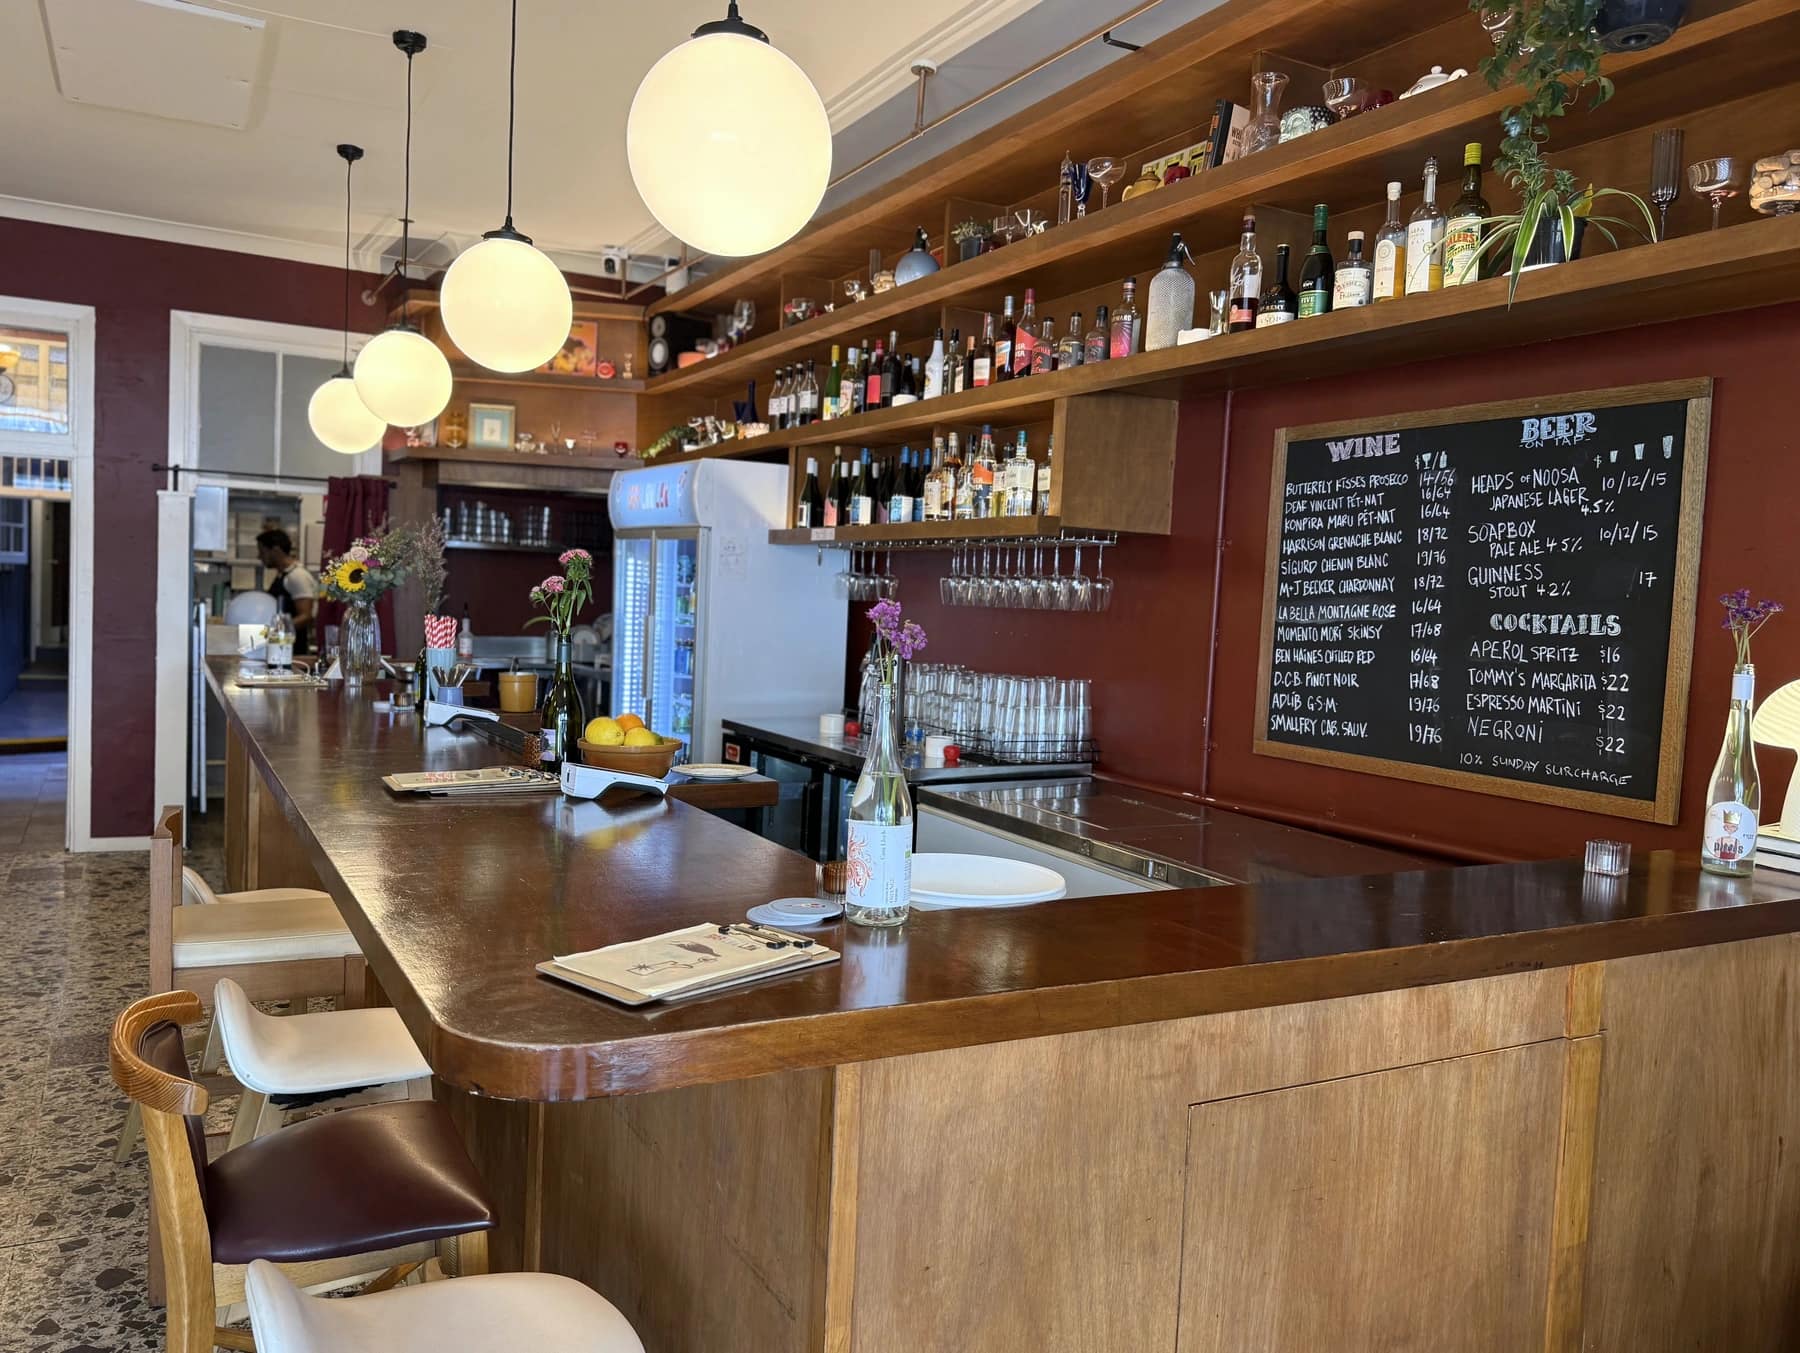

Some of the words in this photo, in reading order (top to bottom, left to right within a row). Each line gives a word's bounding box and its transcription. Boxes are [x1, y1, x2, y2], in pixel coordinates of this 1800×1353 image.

[1520, 412, 1597, 443] BEER
[1326, 434, 1400, 462] WINE
[1286, 480, 1332, 497] BUTTERFLY
[1336, 476, 1366, 492] KISSES
[1369, 473, 1408, 488] PROSECCO
[1419, 468, 1456, 488] 14/56
[1472, 472, 1514, 494] HEADS
[1533, 466, 1580, 489] NOOSA
[1310, 497, 1344, 512] VINCENT
[1421, 485, 1452, 502] 16/64
[1490, 491, 1544, 511] JAPANESE
[1548, 487, 1590, 506] LAGER
[1581, 499, 1616, 516] 4.5%
[1284, 515, 1324, 534] KONPIRA
[1327, 514, 1354, 530] MARU
[1420, 503, 1450, 520] 16/64
[1282, 534, 1326, 555] HARRISON
[1328, 532, 1372, 550] GRENACHE
[1374, 530, 1403, 545] BLANC
[1418, 527, 1448, 544] 18/72
[1468, 520, 1536, 544] SOAPBOX
[1281, 558, 1318, 576] SIGURD
[1321, 557, 1353, 574] CHENIN
[1356, 552, 1389, 569] BLANC
[1417, 549, 1446, 567] 19/76
[1489, 542, 1515, 559] PALE
[1519, 540, 1544, 556] ALE
[1280, 580, 1302, 598] M+J
[1303, 580, 1336, 596] BECKER
[1338, 576, 1395, 594] CHARDONNAY
[1414, 576, 1445, 591] 18/72
[1468, 563, 1543, 588] GUINNESS
[1639, 571, 1657, 588] 17
[1489, 584, 1527, 600] STOUT
[1536, 580, 1571, 597] 4.2%
[1278, 604, 1288, 621] LA
[1289, 605, 1315, 622] BELLA
[1318, 604, 1369, 620] MONTAGNE
[1372, 603, 1397, 618] ROSE
[1412, 598, 1443, 615] 16/64
[1278, 625, 1318, 642] MOMENTO
[1320, 623, 1344, 641] MORI
[1347, 624, 1383, 640] SKINSY
[1411, 622, 1442, 639] 17/68
[1490, 613, 1622, 638] COCKTAILS
[1276, 648, 1290, 665] BEN
[1293, 648, 1324, 665] HAINES
[1324, 648, 1354, 664] CHILLED
[1356, 650, 1376, 664] RED
[1410, 648, 1438, 666] 16/64
[1470, 639, 1529, 663] APEROL
[1531, 645, 1580, 663] SPRITZ
[1600, 645, 1620, 664] $16
[1305, 672, 1332, 688] PINOT
[1334, 672, 1360, 688] NOIR
[1410, 670, 1440, 690] 17/68
[1468, 667, 1526, 687] TOMMY'S
[1532, 672, 1597, 692] MARGARITA
[1600, 671, 1630, 692] $22
[1272, 691, 1302, 712] ADLIB
[1409, 696, 1440, 713] 19/76
[1466, 693, 1525, 712] ESPRESSO
[1528, 696, 1581, 718] MARTINI
[1598, 700, 1626, 722] $22
[1270, 714, 1317, 737] SMALLFRY
[1320, 719, 1340, 737] CAB.
[1341, 721, 1368, 738] SAUV.
[1409, 722, 1442, 745] 19/76
[1467, 716, 1544, 744] NEGRONI
[1595, 728, 1625, 756] $22
[1459, 752, 1483, 766] 10%
[1492, 754, 1540, 773] SUNDAY
[1545, 764, 1633, 786] SURCHARGE
